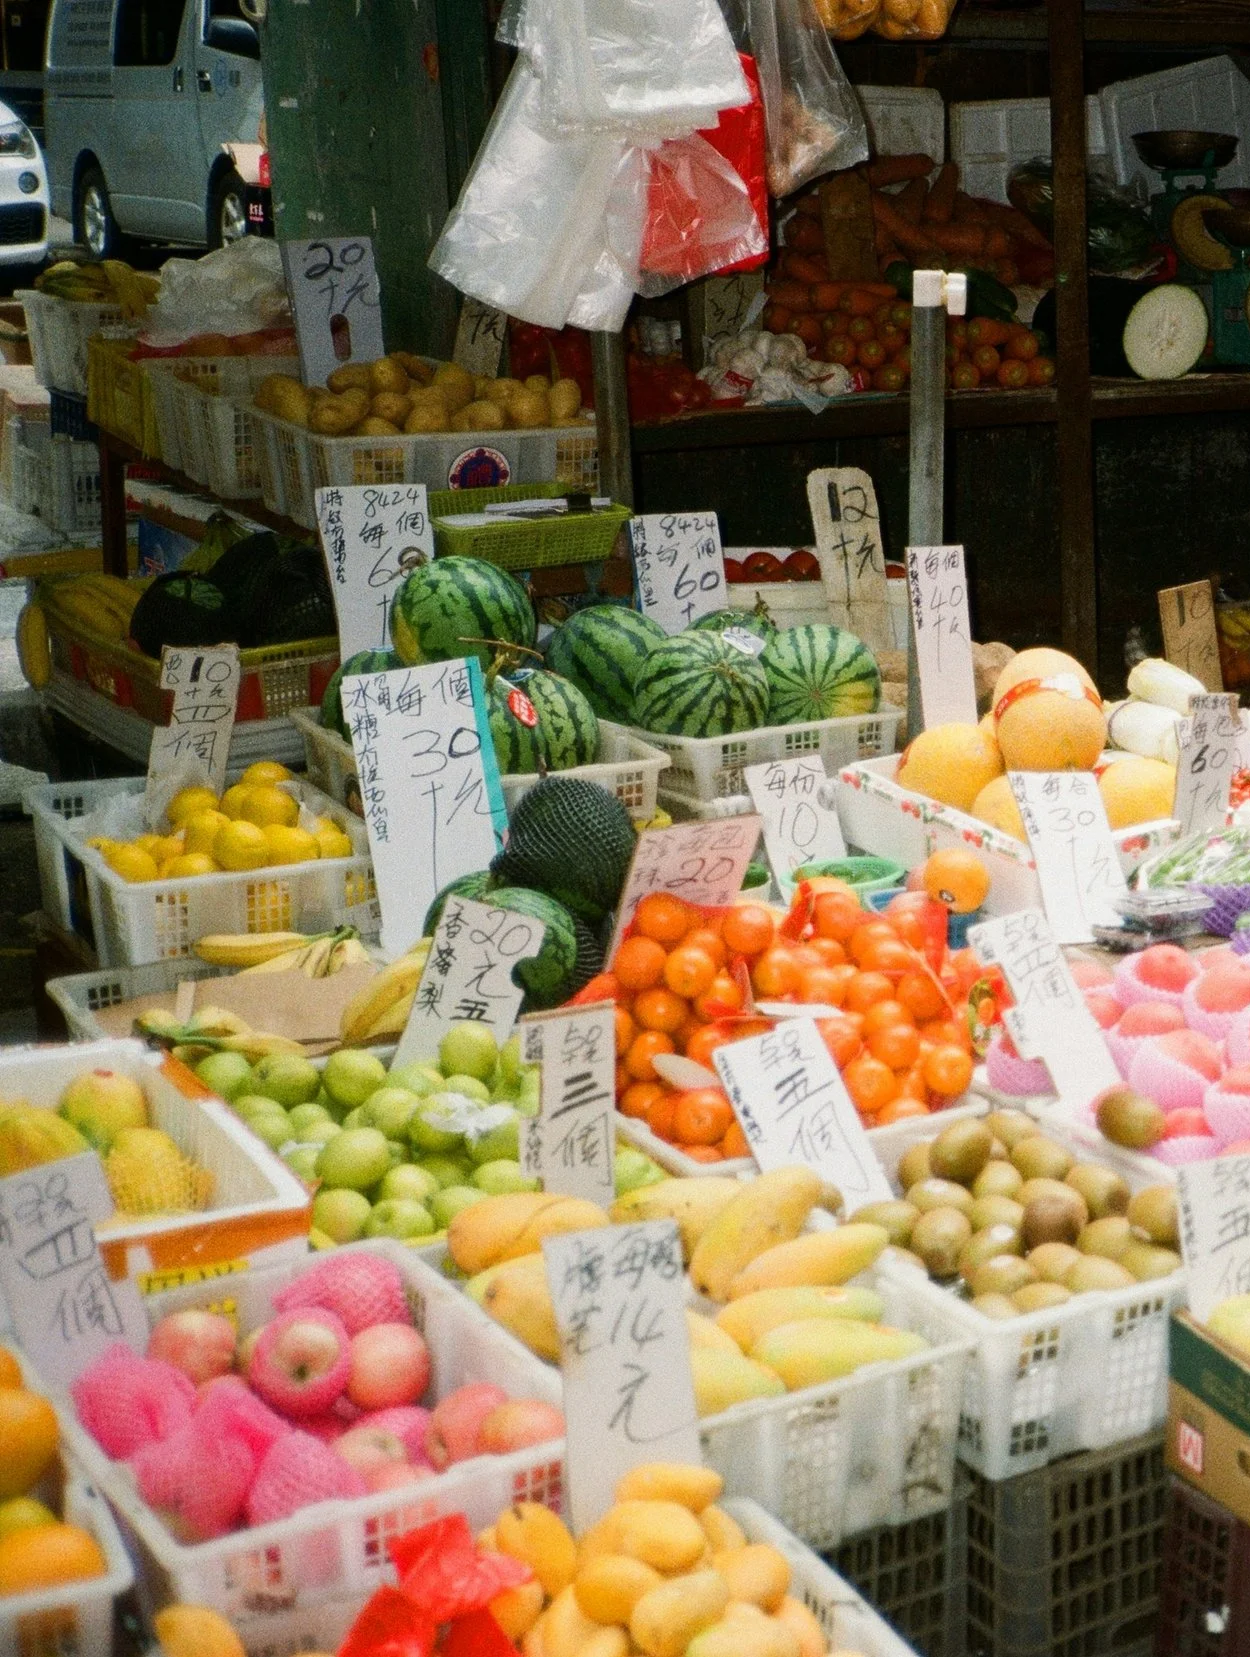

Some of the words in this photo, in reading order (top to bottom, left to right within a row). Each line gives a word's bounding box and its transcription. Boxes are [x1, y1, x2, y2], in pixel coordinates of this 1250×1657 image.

[304, 242, 366, 279] 20
[362, 487, 420, 518] 8424
[827, 481, 878, 523] 12
[659, 515, 716, 539] 8424
[673, 563, 721, 600] 60
[929, 584, 964, 611] 40
[189, 656, 232, 683] 10
[402, 726, 482, 778] 30
[1190, 743, 1229, 775] 60
[778, 801, 819, 847] 10
[1047, 807, 1096, 832] 30
[665, 857, 735, 889] 20
[469, 909, 532, 956] 20
